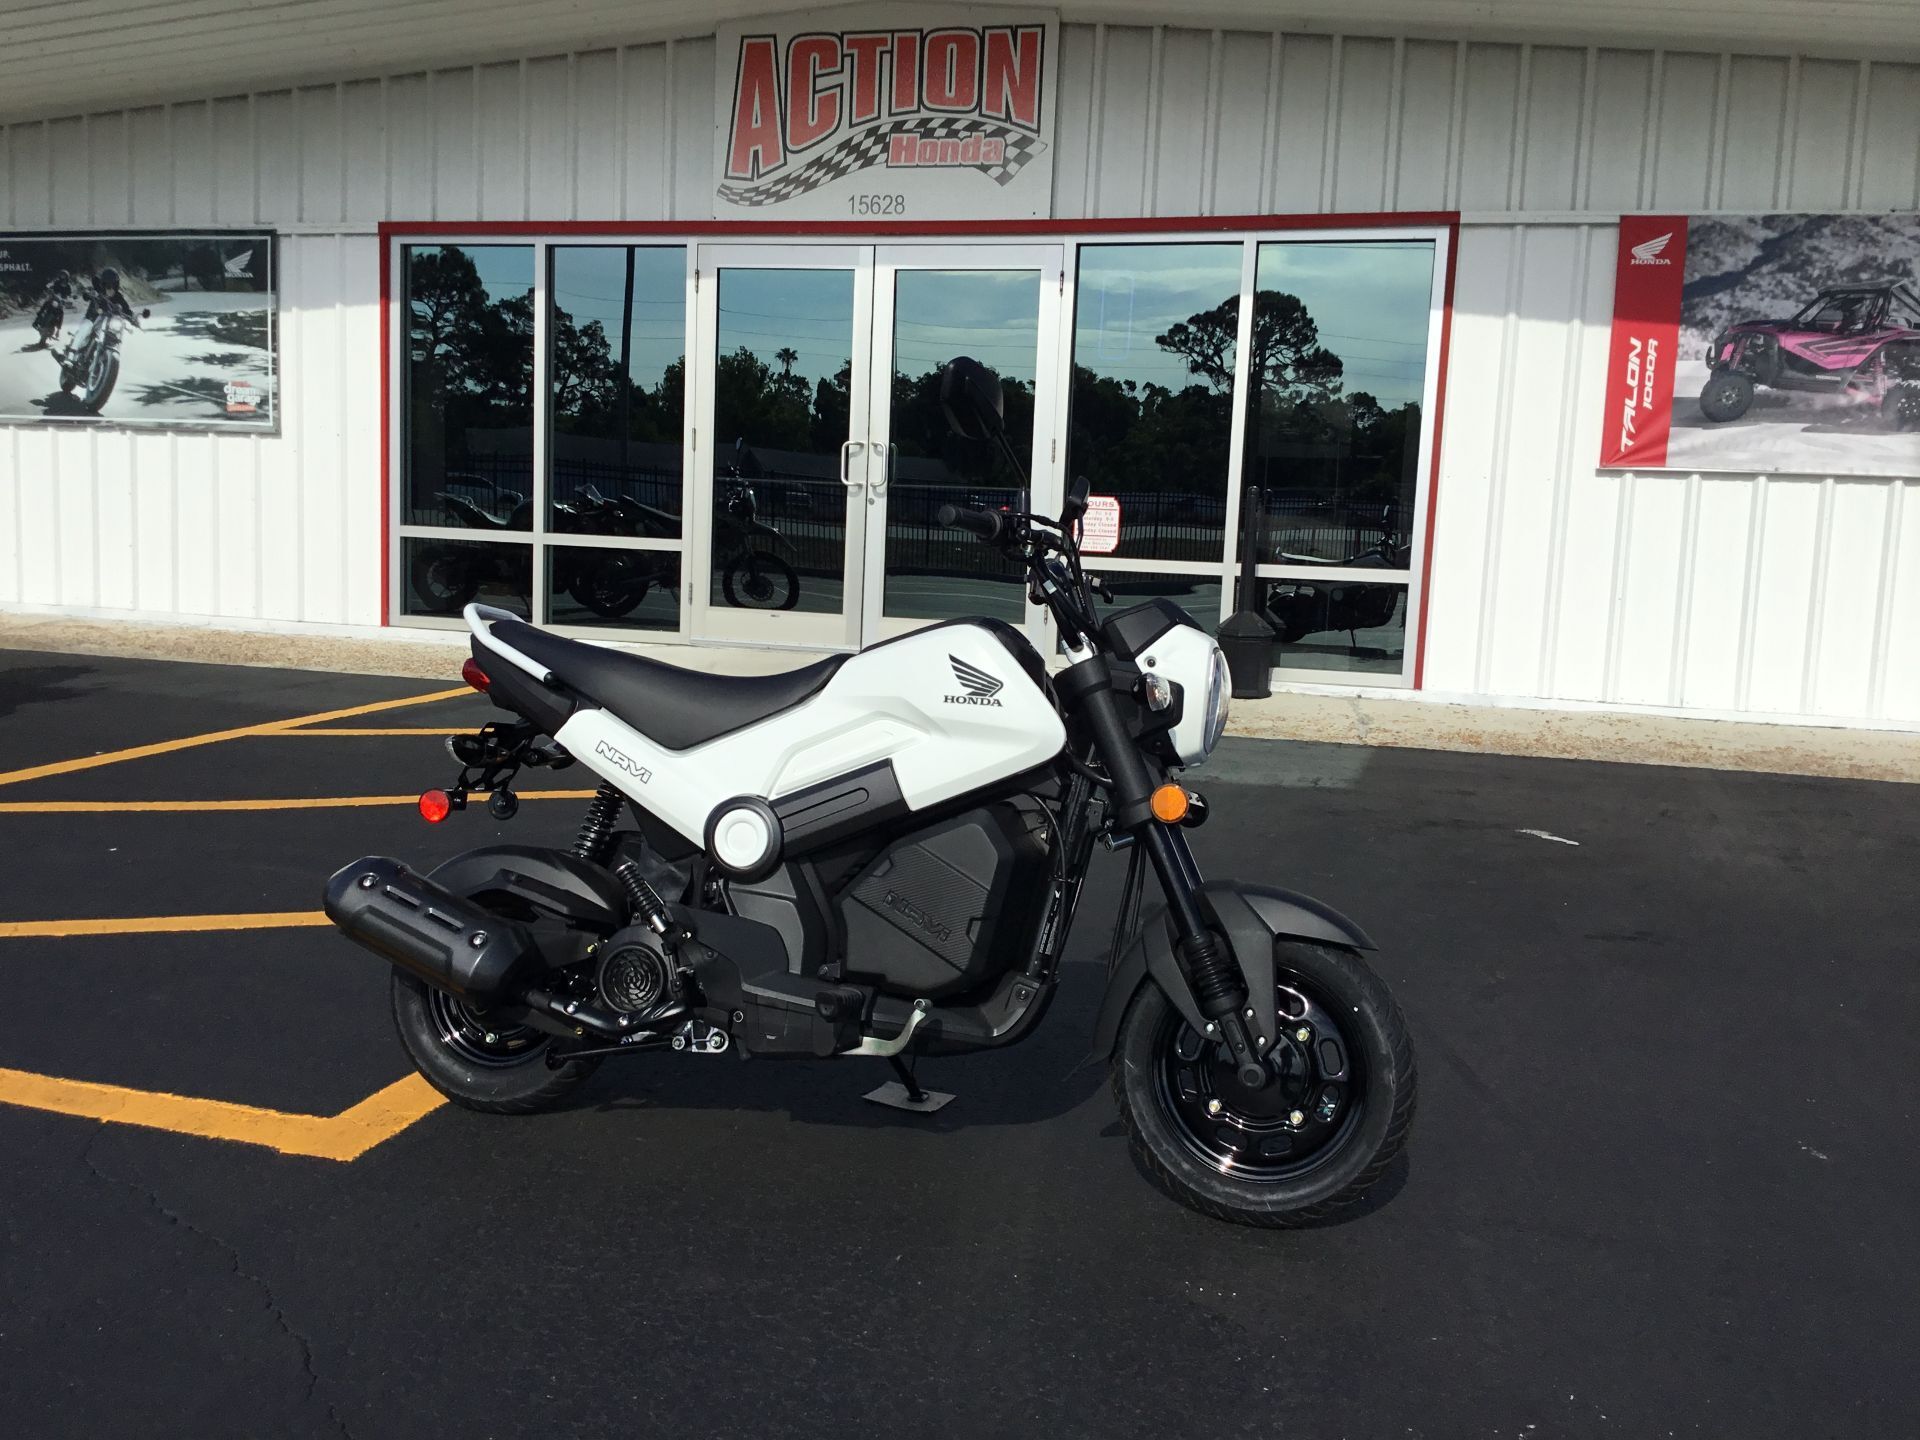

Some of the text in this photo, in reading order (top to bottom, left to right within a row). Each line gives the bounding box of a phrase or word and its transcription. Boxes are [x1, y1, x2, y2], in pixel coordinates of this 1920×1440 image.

[724, 24, 1046, 181] ACTION
[887, 130, 1006, 167] Honda
[848, 194, 906, 215] 15628
[1621, 336, 1642, 452] TALON
[1643, 338, 1659, 410] 1000R
[943, 694, 1003, 707] HONDA
[595, 740, 653, 784] NAVI
[882, 890, 952, 944] NAVI
